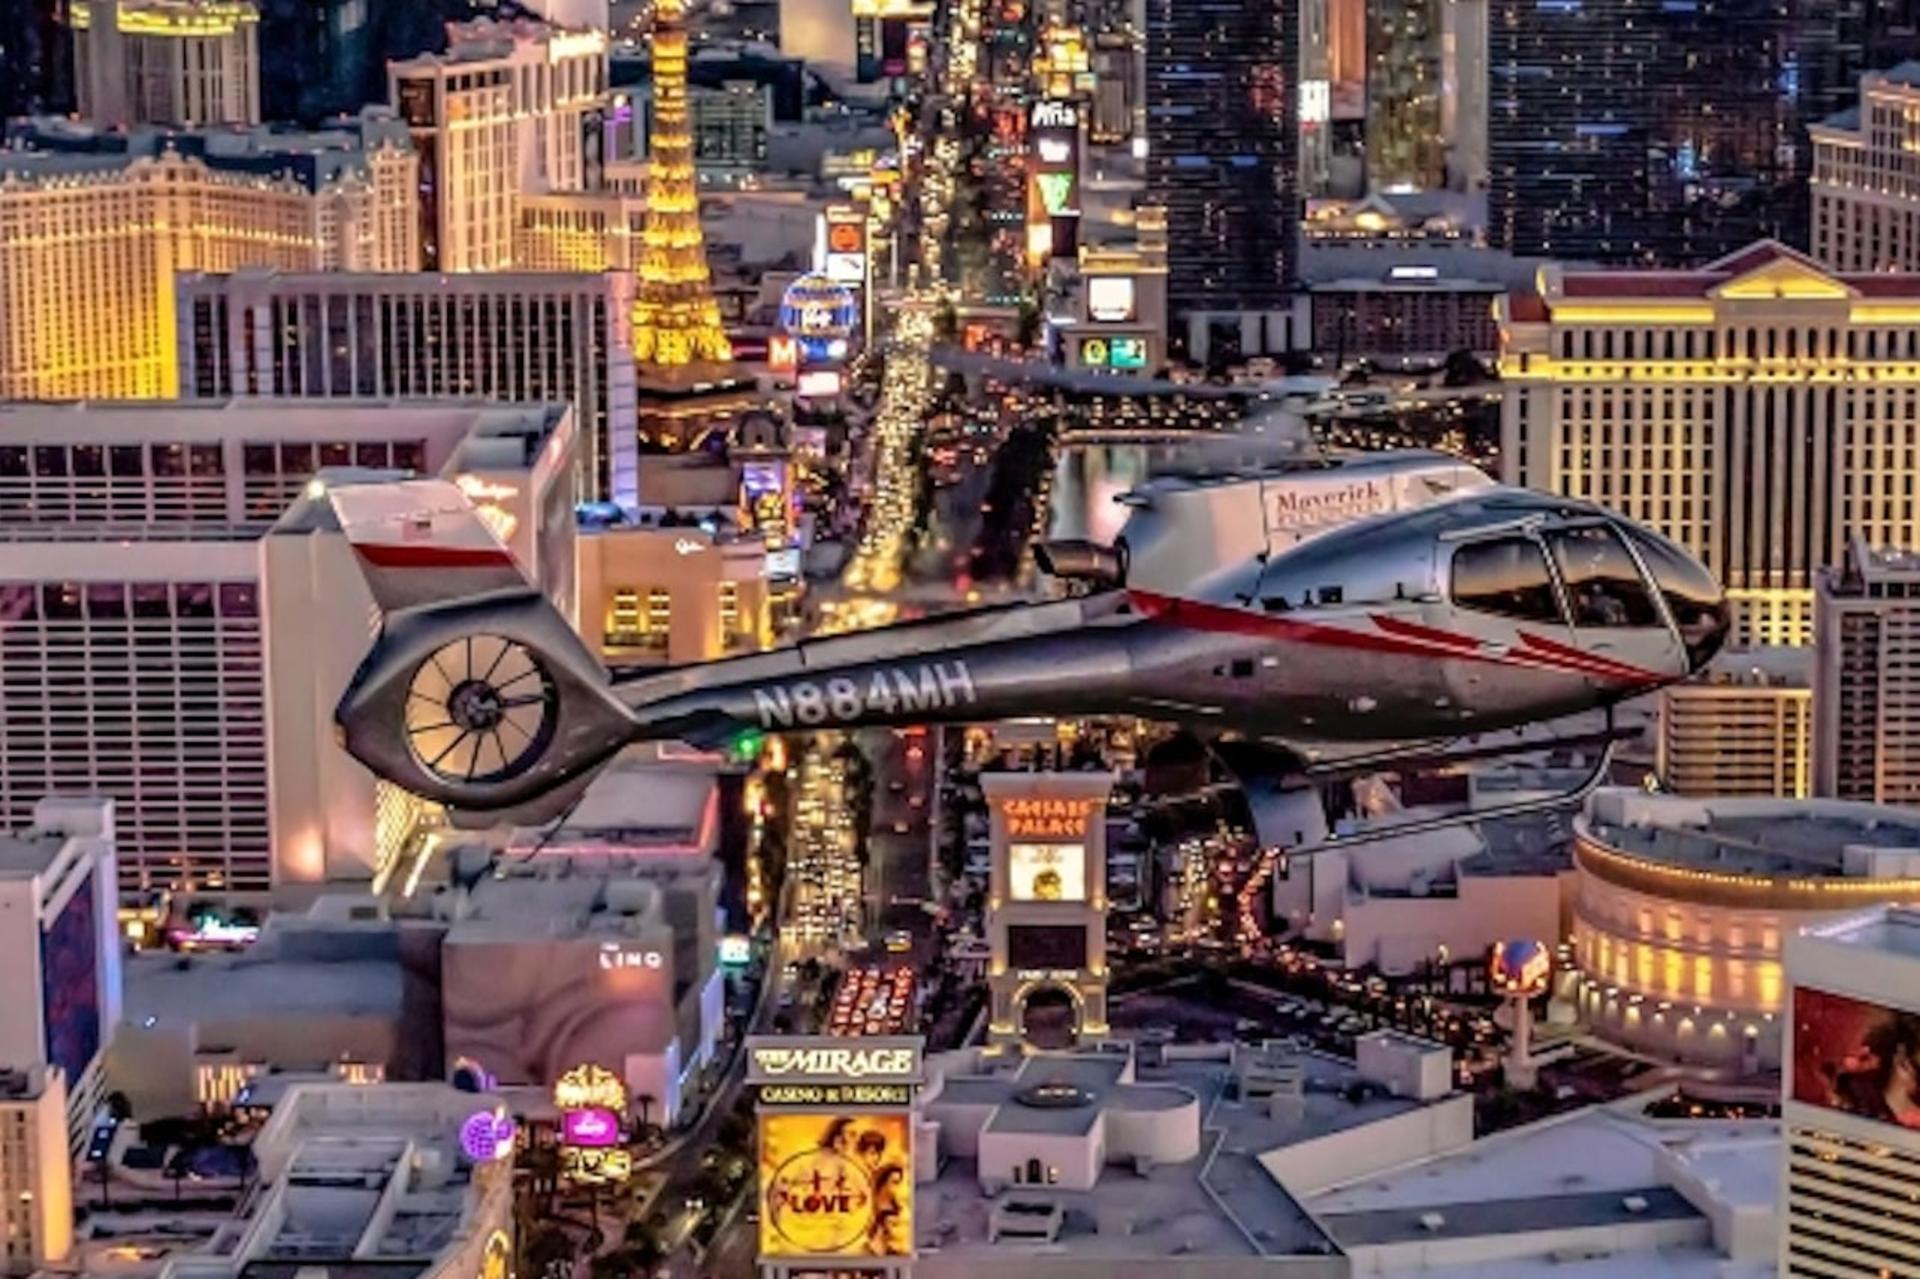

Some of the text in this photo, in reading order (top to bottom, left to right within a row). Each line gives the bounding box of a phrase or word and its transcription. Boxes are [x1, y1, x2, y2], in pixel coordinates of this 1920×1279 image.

[1278, 481, 1380, 511] Maverick
[753, 660, 977, 729] N884MH
[766, 1049, 913, 1078] MIRAGE
[761, 1086, 824, 1103] CASINO
[841, 1086, 908, 1103] RESORT
[790, 1194, 850, 1214] LOVE
